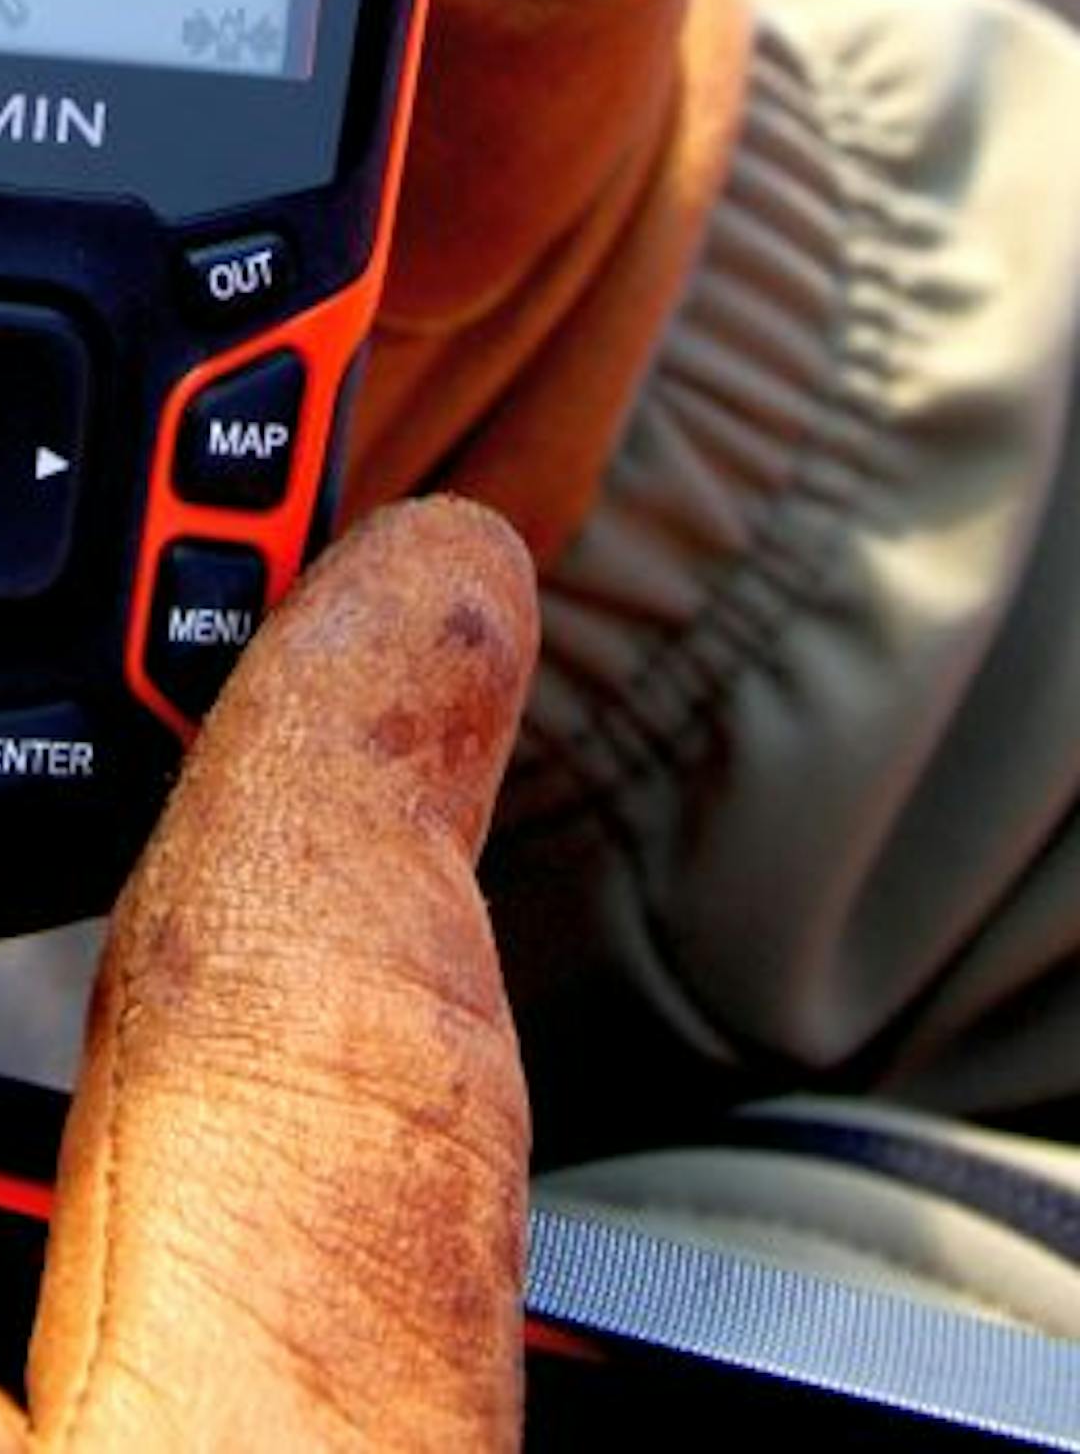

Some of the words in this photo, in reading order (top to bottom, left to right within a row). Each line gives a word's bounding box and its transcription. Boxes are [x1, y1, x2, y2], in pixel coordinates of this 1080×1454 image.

[209, 250, 274, 301] OUT
[209, 420, 289, 460] MAP
[168, 605, 252, 646] MENU
